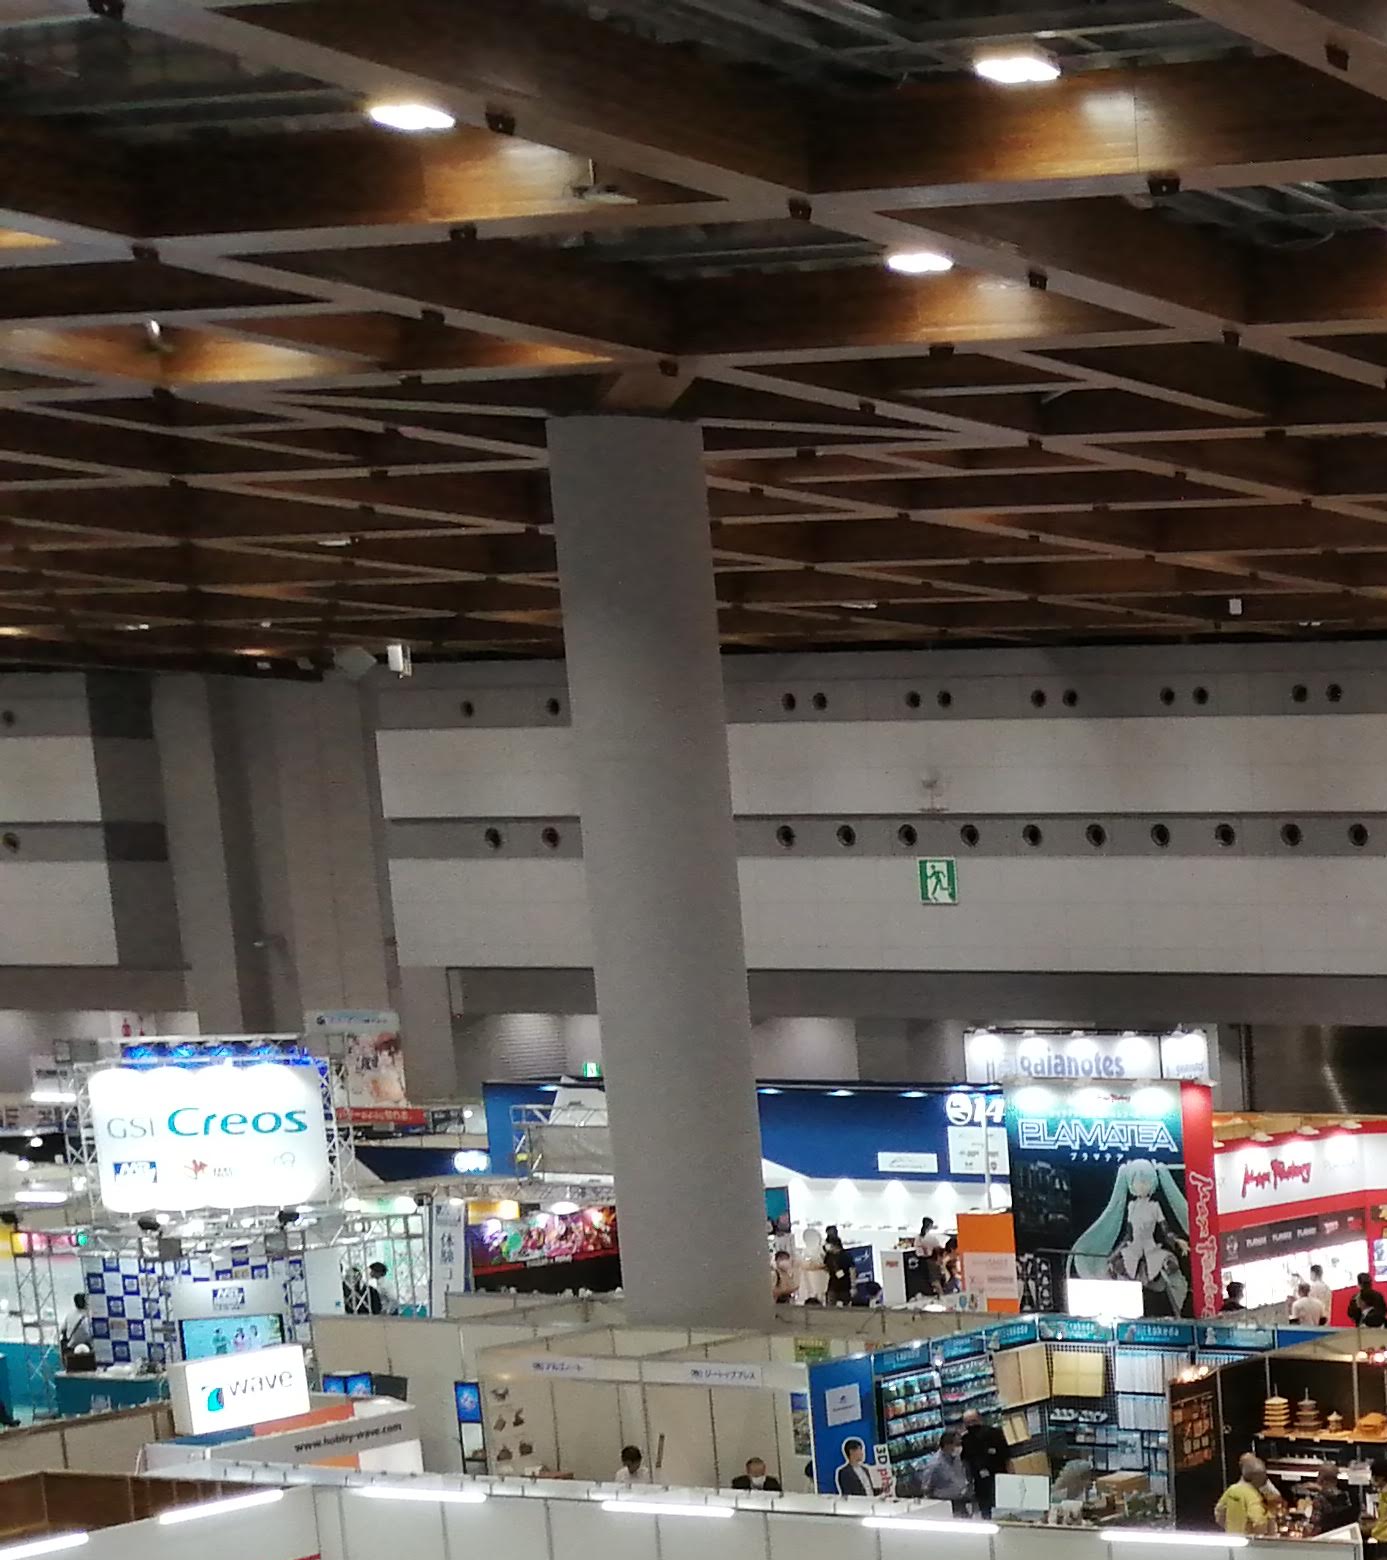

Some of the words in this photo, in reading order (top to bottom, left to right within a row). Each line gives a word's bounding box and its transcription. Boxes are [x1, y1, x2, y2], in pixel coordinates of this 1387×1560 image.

[106, 1117, 155, 1139] GSI
[167, 1107, 308, 1137] Creos
[1018, 1118, 1179, 1153] PLAMATEA
[229, 1371, 293, 1395] wave
